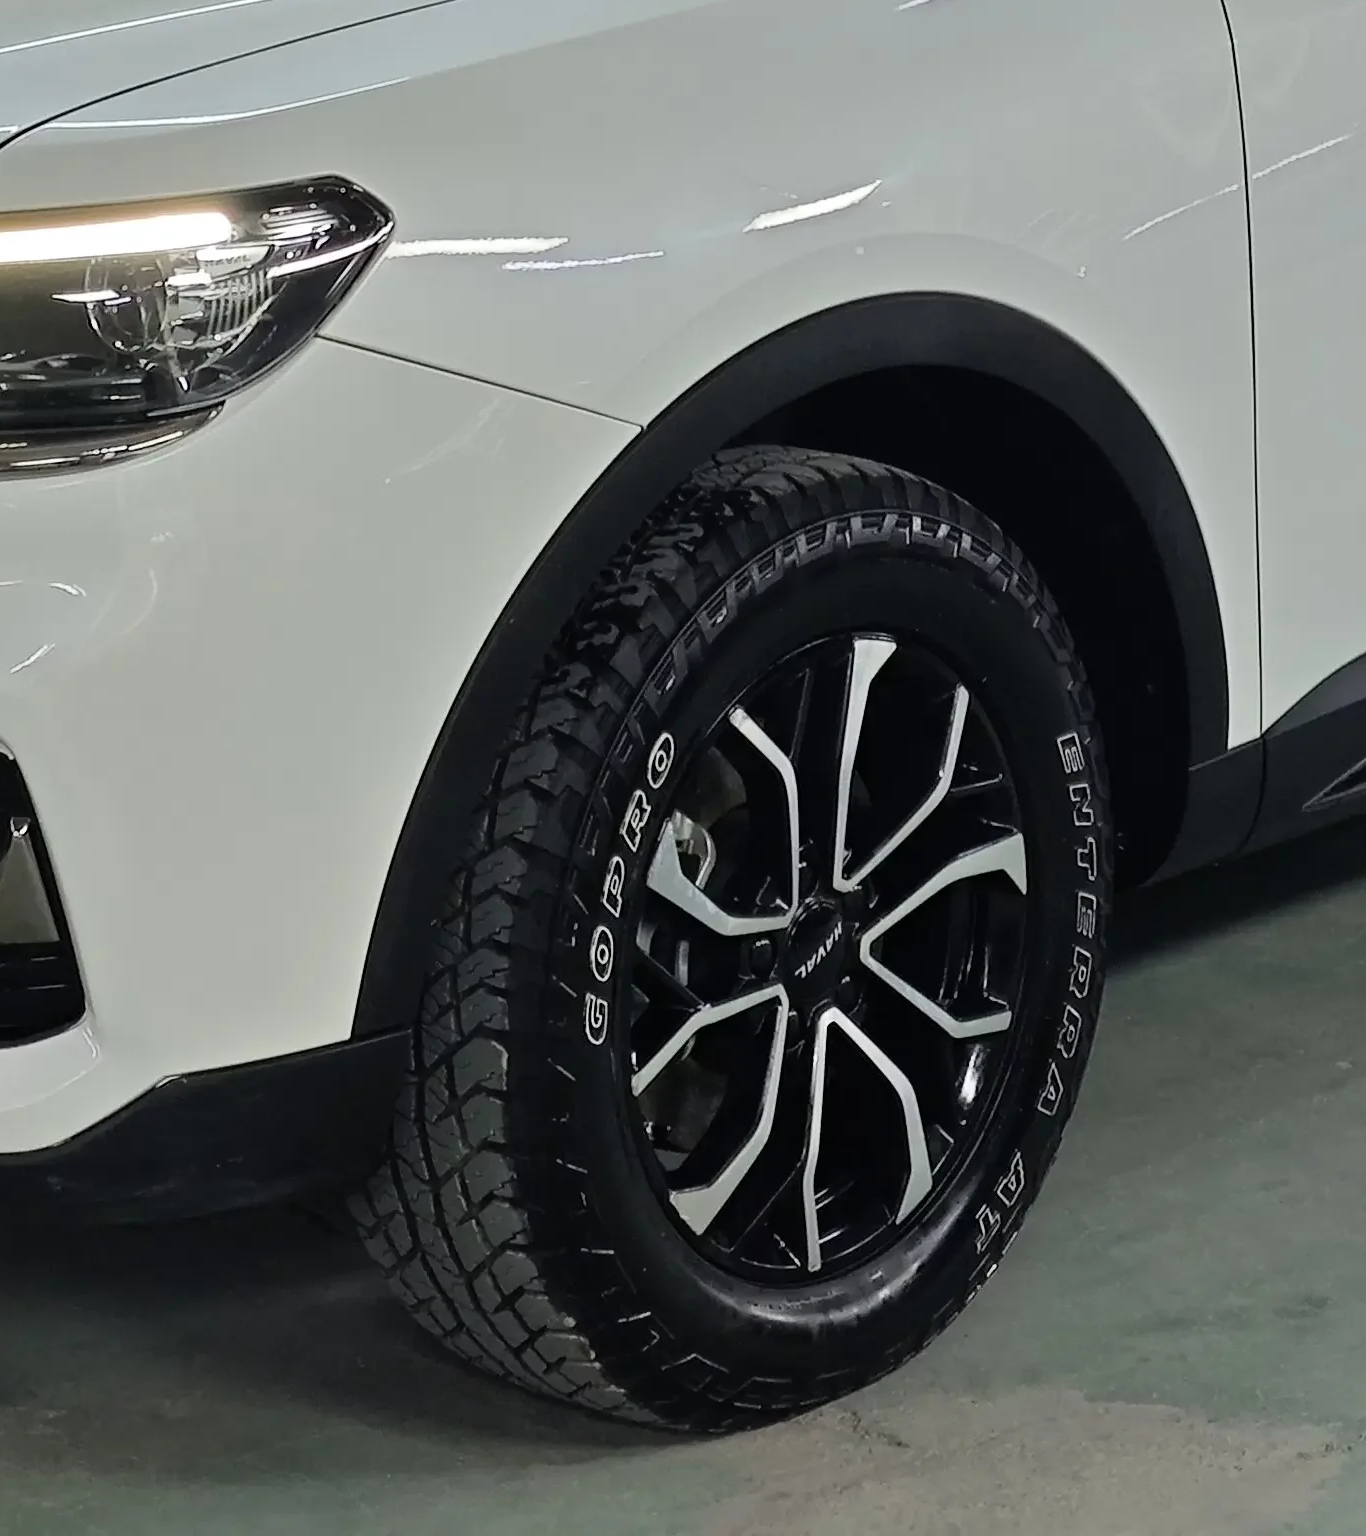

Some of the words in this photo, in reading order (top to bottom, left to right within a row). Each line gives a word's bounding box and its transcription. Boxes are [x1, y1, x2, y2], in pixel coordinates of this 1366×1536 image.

[583, 731, 676, 1046] GOPRO
[794, 921, 843, 979] HAVAL
[1037, 730, 1098, 1117] ENTERRA
[975, 1151, 1025, 1255] AT
